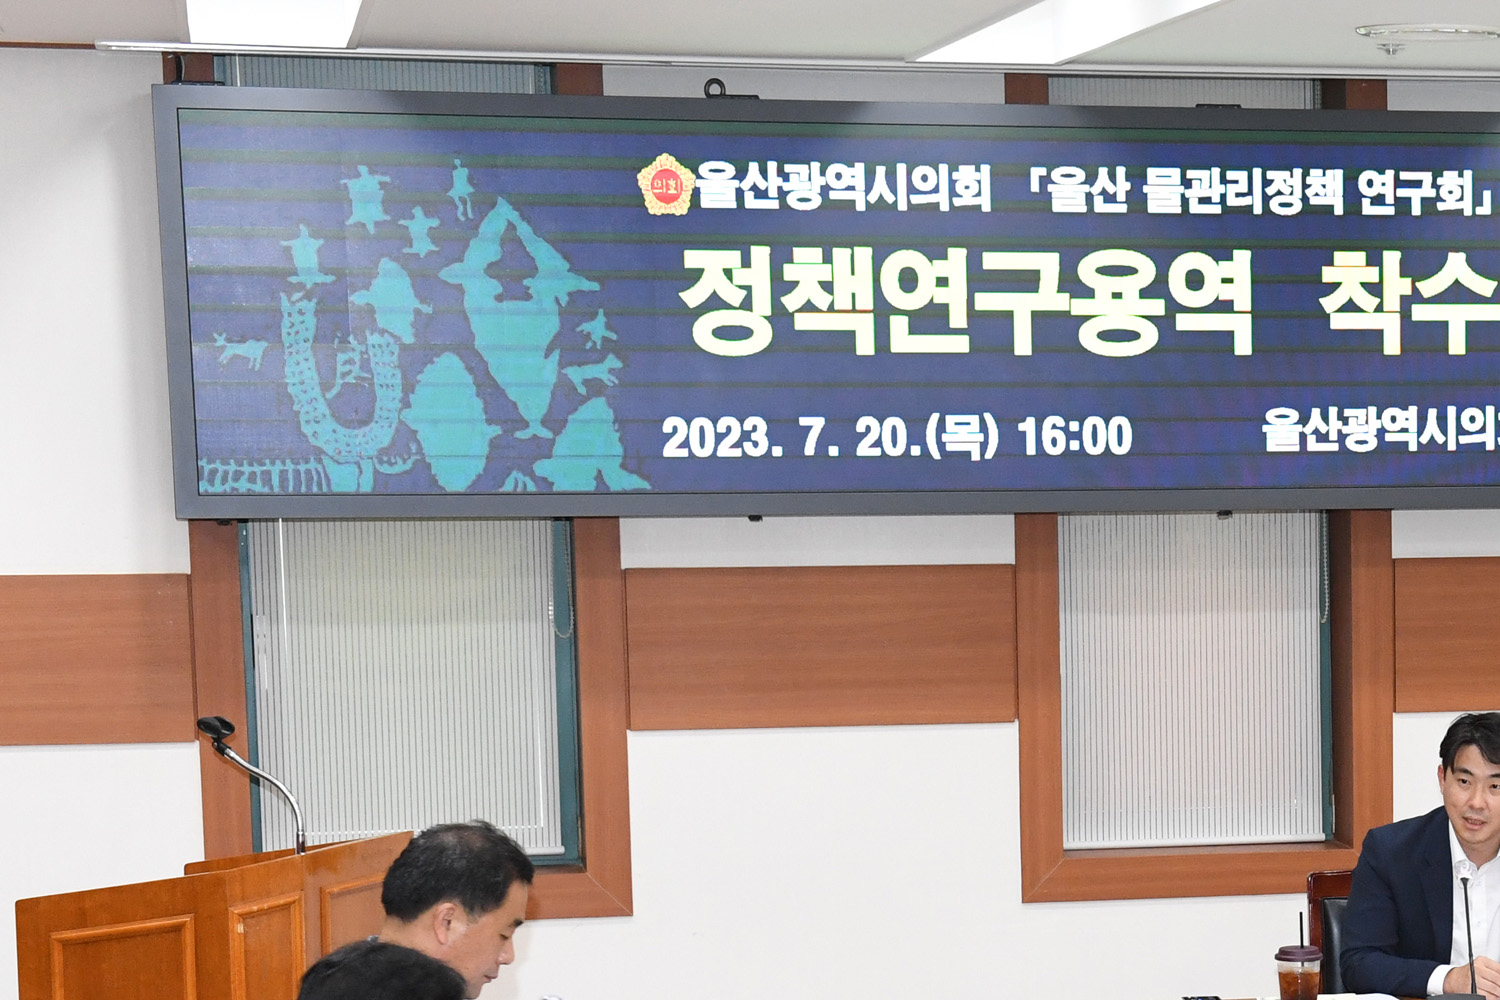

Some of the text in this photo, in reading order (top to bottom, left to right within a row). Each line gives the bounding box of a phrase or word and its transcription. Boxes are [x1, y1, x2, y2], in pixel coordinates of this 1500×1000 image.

[695, 161, 991, 212] 울산광역시의회
[1030, 166, 1131, 213] 「울산
[1143, 168, 1343, 216] 물관리정책
[1358, 170, 1491, 216] 연구회」
[679, 246, 1252, 356] 정책연구용역
[1319, 251, 1500, 355] 착수
[663, 412, 1132, 461] 2023. 7. 20.(목) 16:00
